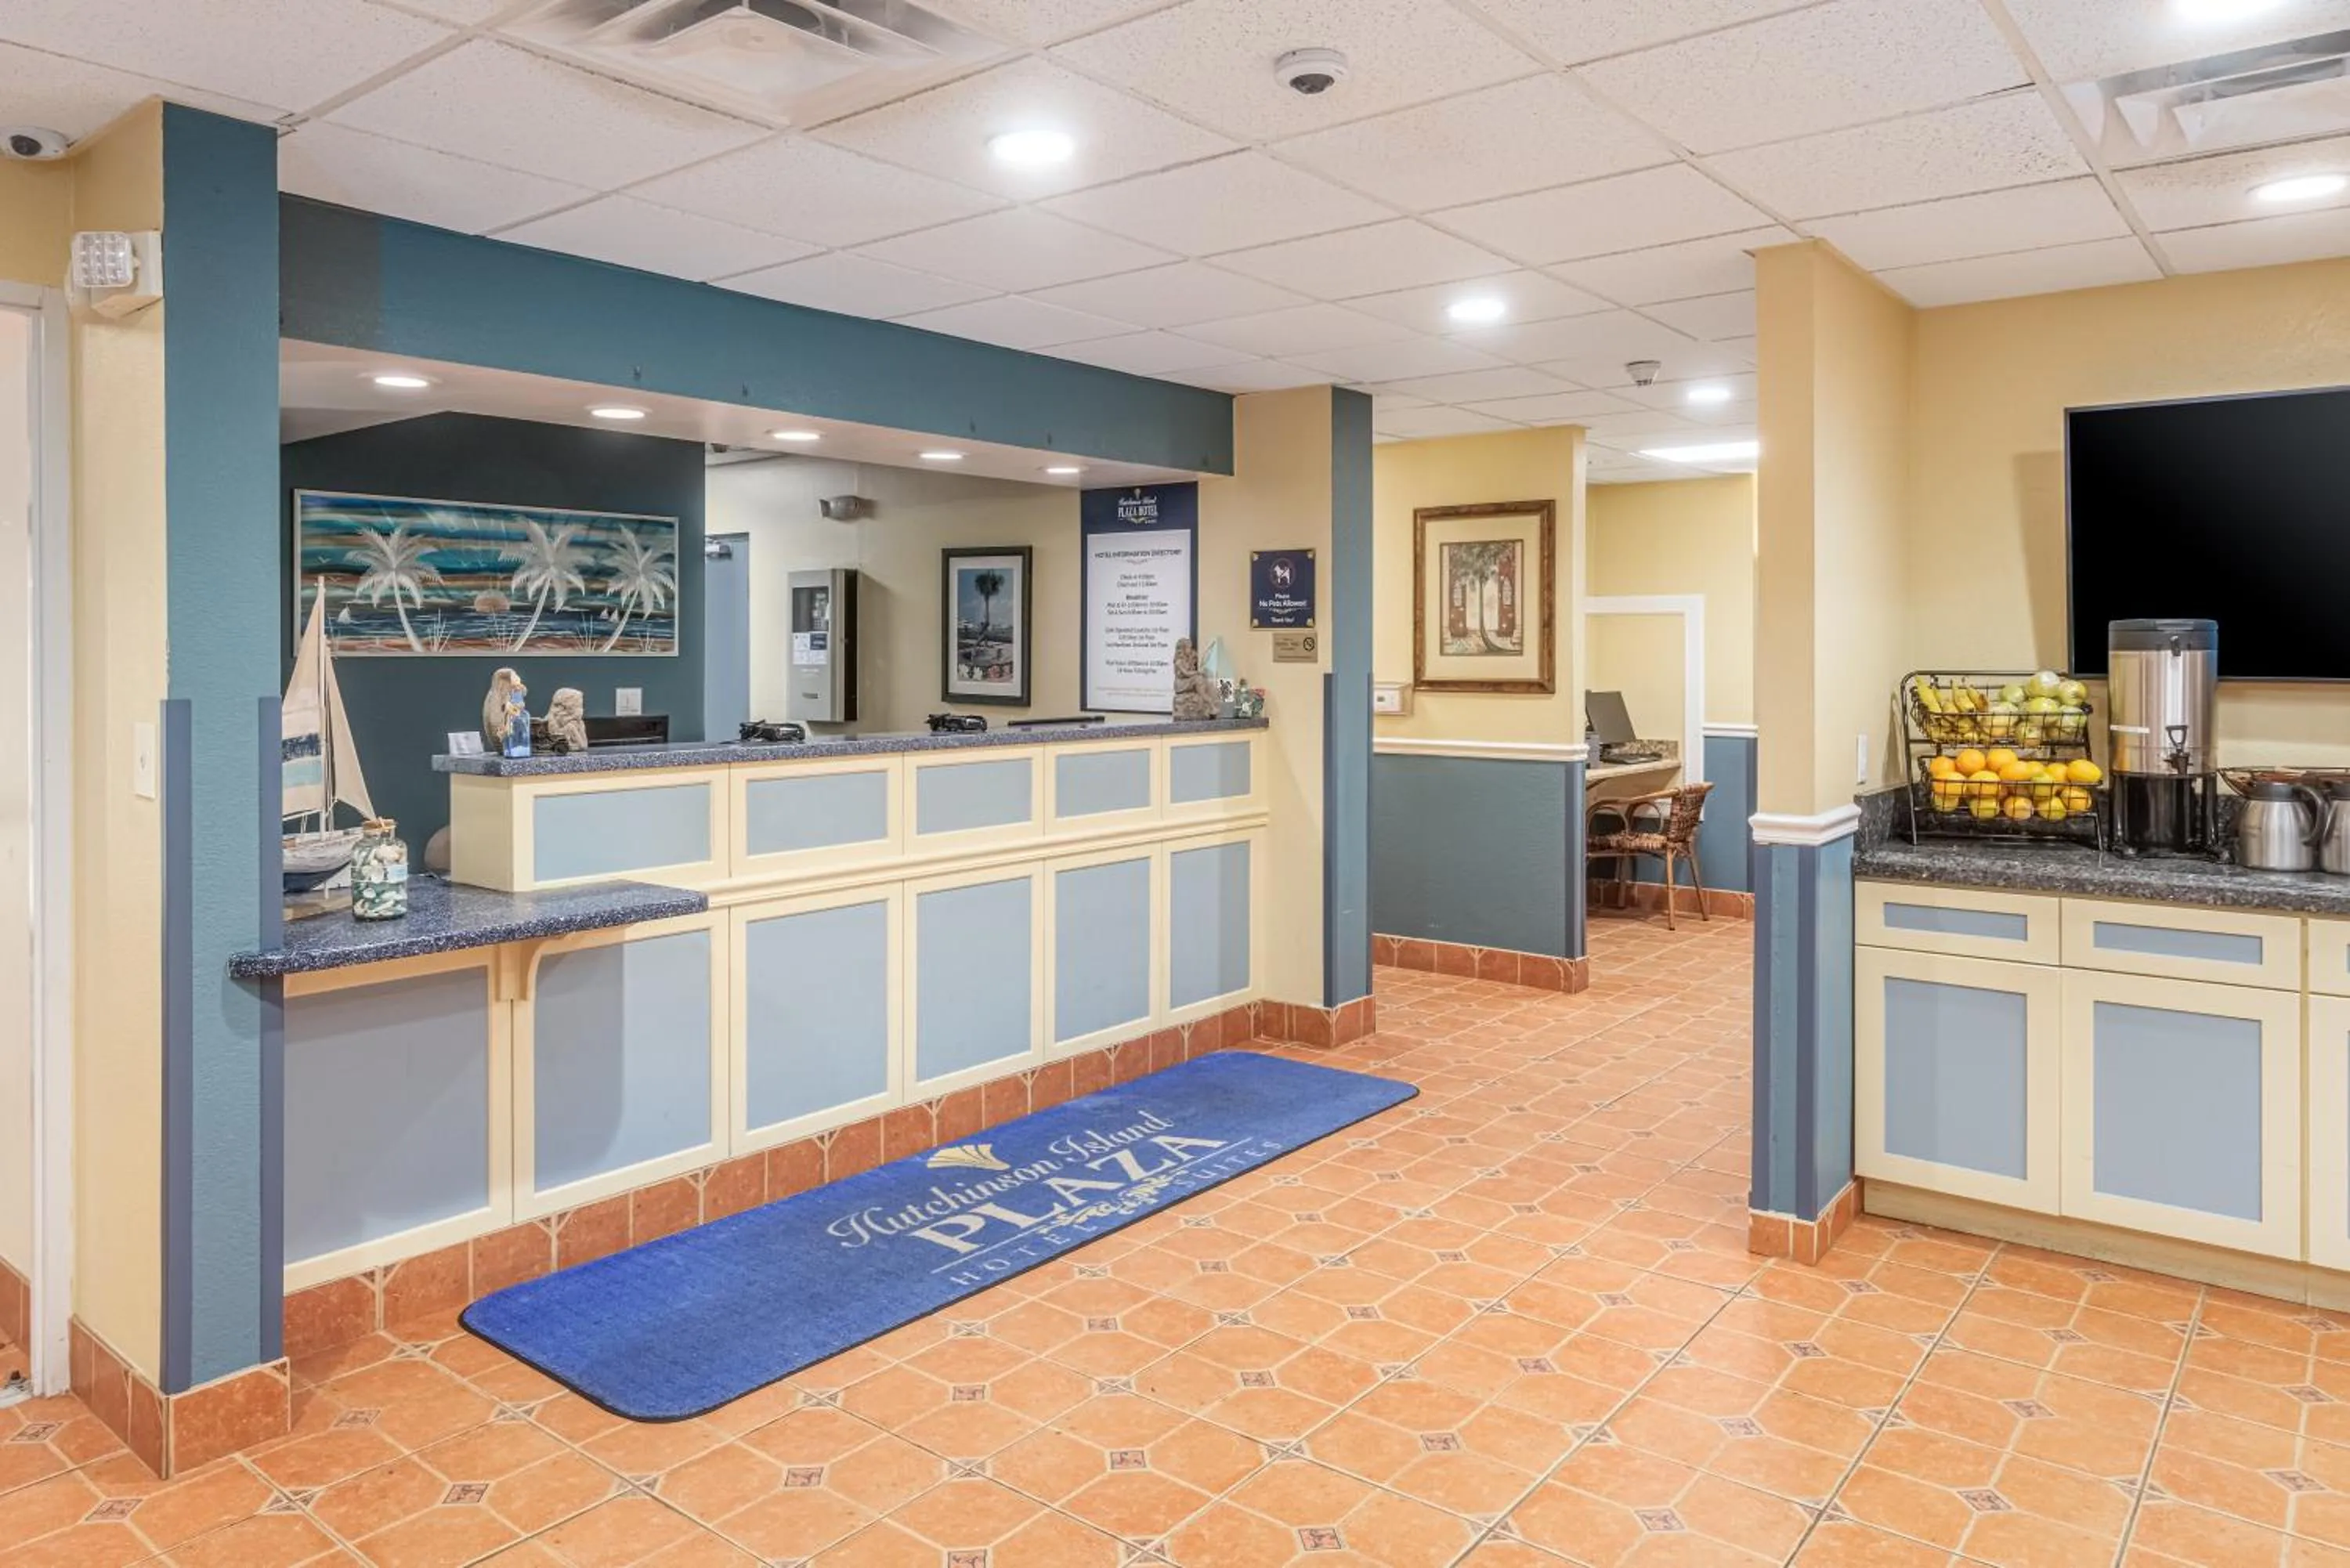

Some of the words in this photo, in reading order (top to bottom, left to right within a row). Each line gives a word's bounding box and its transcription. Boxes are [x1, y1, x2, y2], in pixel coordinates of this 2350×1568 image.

[827, 1158, 1064, 1248] Hutchinson
[1048, 1109, 1176, 1162] Island
[907, 1135, 1229, 1254] PLAZA
[949, 1223, 1098, 1286] HOTEL
[1173, 1140, 1283, 1189] SUITES
